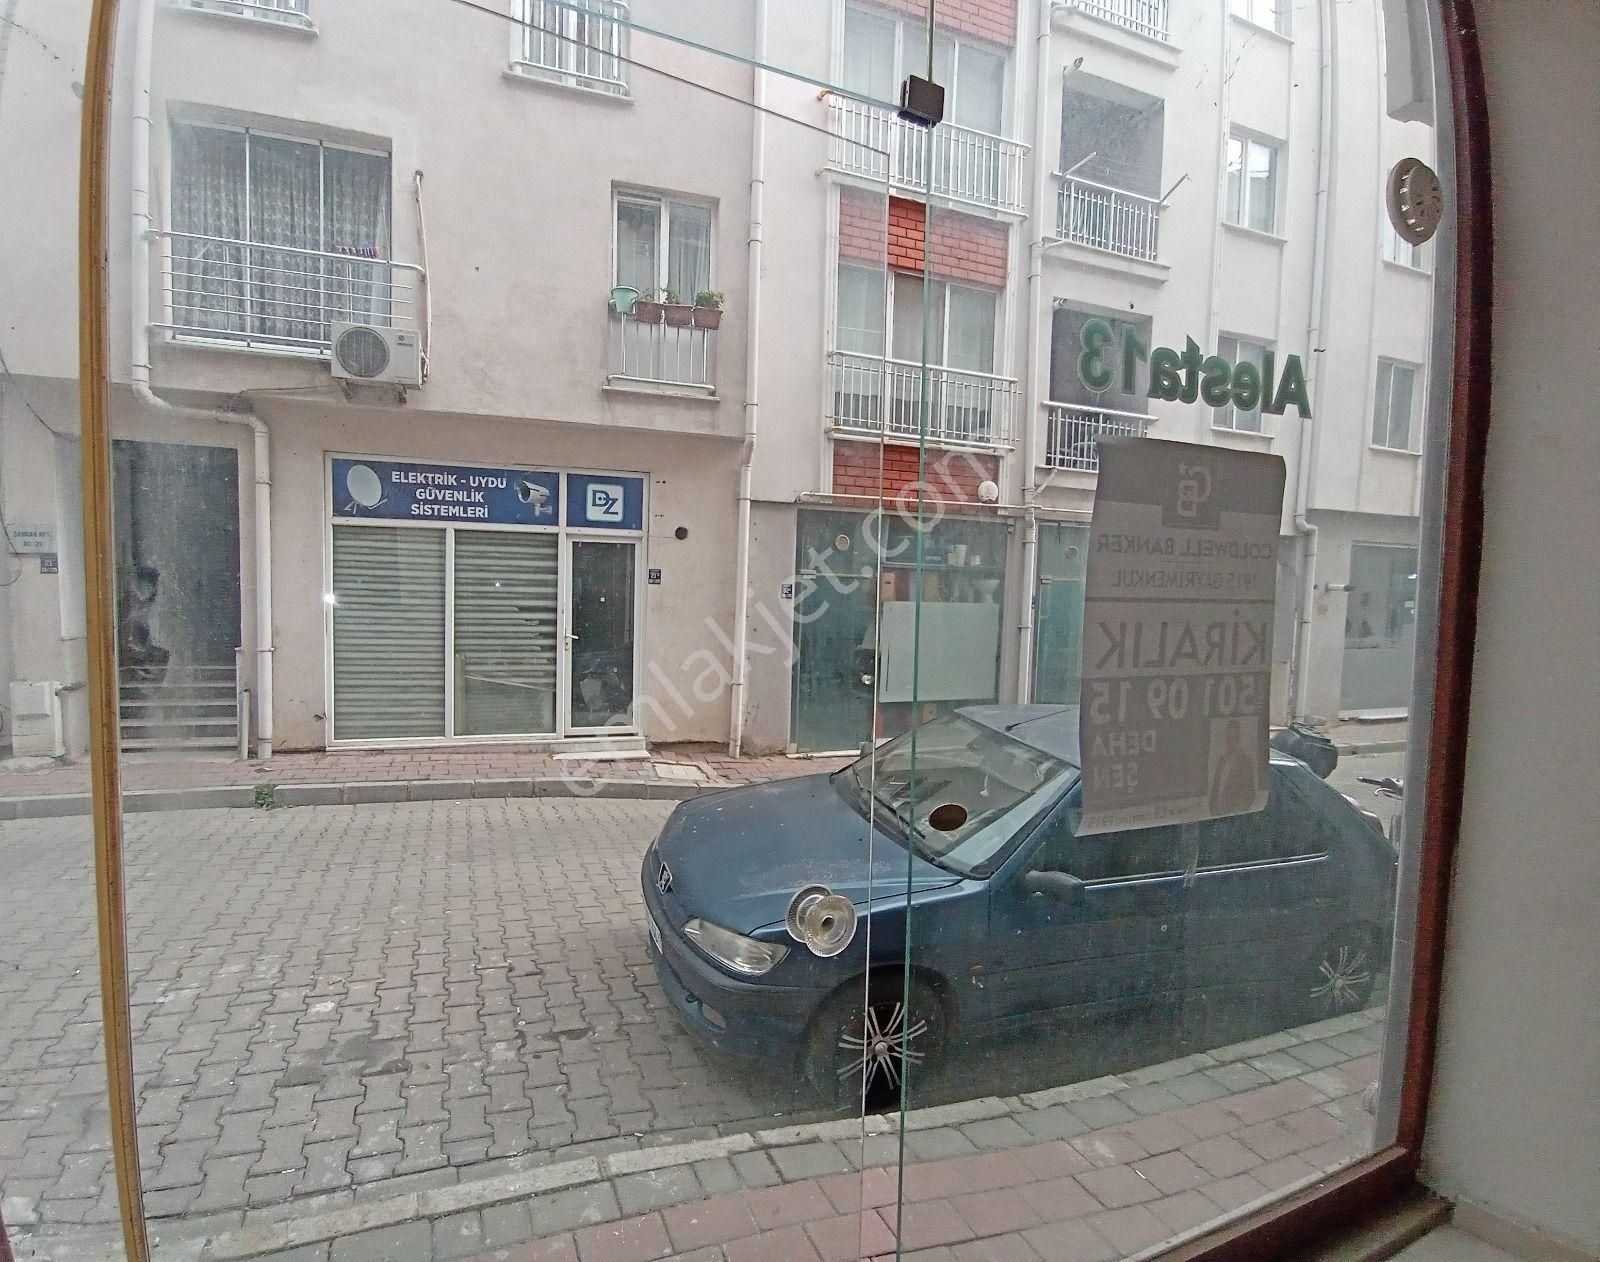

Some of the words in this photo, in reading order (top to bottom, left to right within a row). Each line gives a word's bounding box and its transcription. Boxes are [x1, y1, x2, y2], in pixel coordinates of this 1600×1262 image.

[391, 471, 458, 486] ELEKTRİK
[469, 475, 507, 489] UYDU
[415, 487, 485, 503] GÜVENLİK
[591, 489, 619, 516] DZ
[410, 502, 489, 518] SİSTEMLERİ
